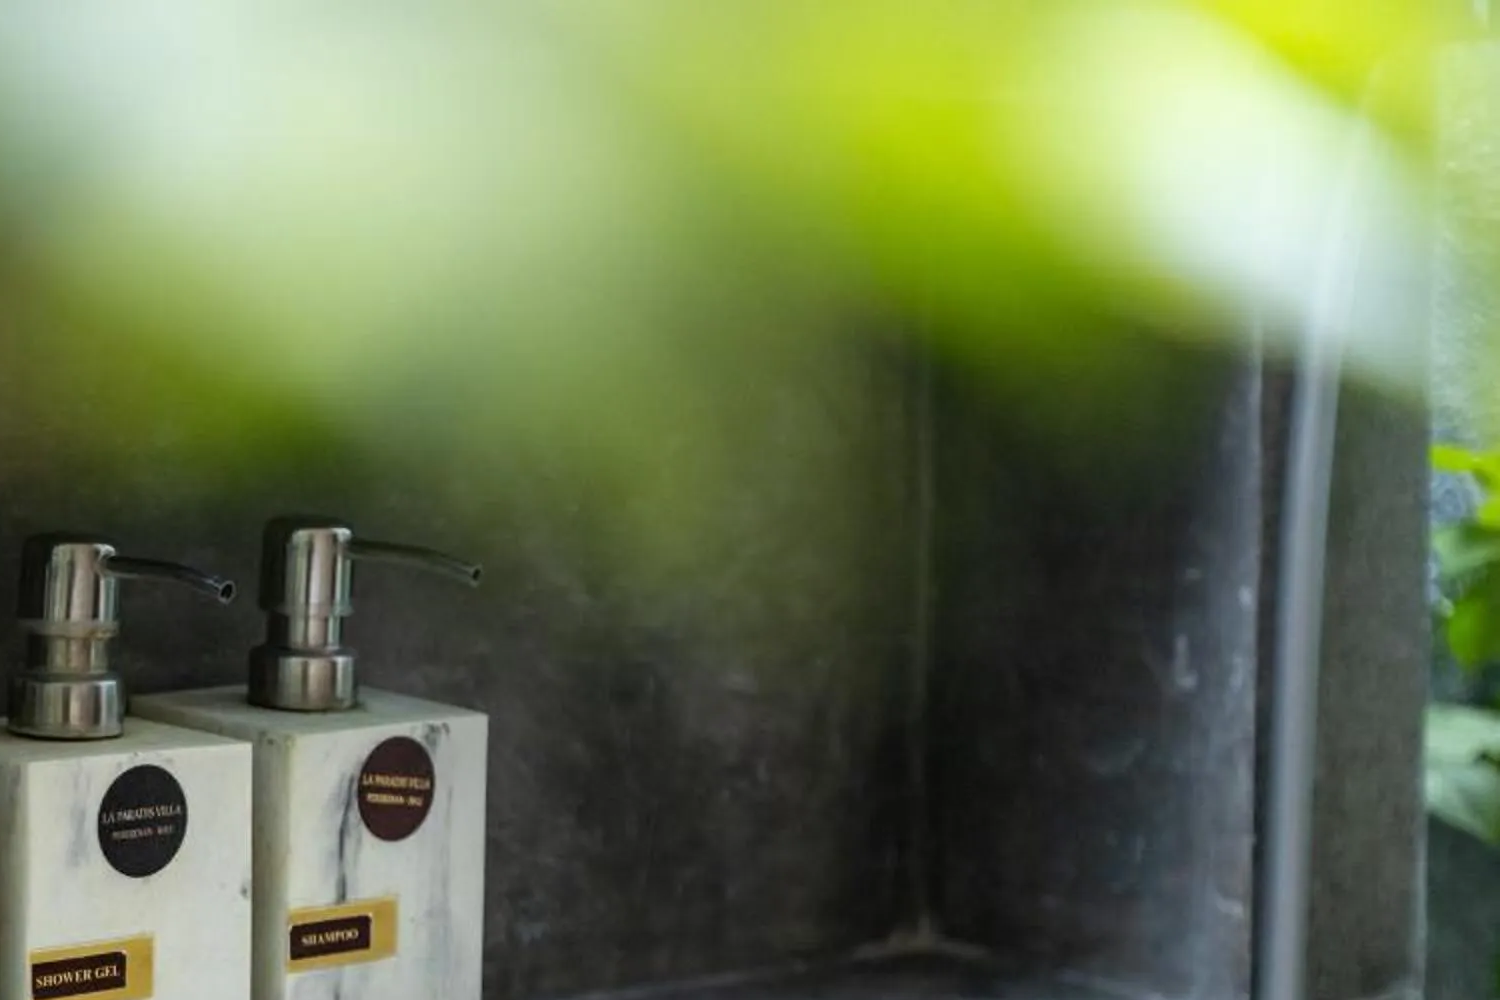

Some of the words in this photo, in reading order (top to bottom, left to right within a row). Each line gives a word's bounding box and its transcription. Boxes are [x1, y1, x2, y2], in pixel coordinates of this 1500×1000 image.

[101, 811, 115, 824] LA
[301, 928, 360, 946] SHAMPOO
[35, 969, 93, 989] SHOWER
[94, 965, 120, 980] GEL
